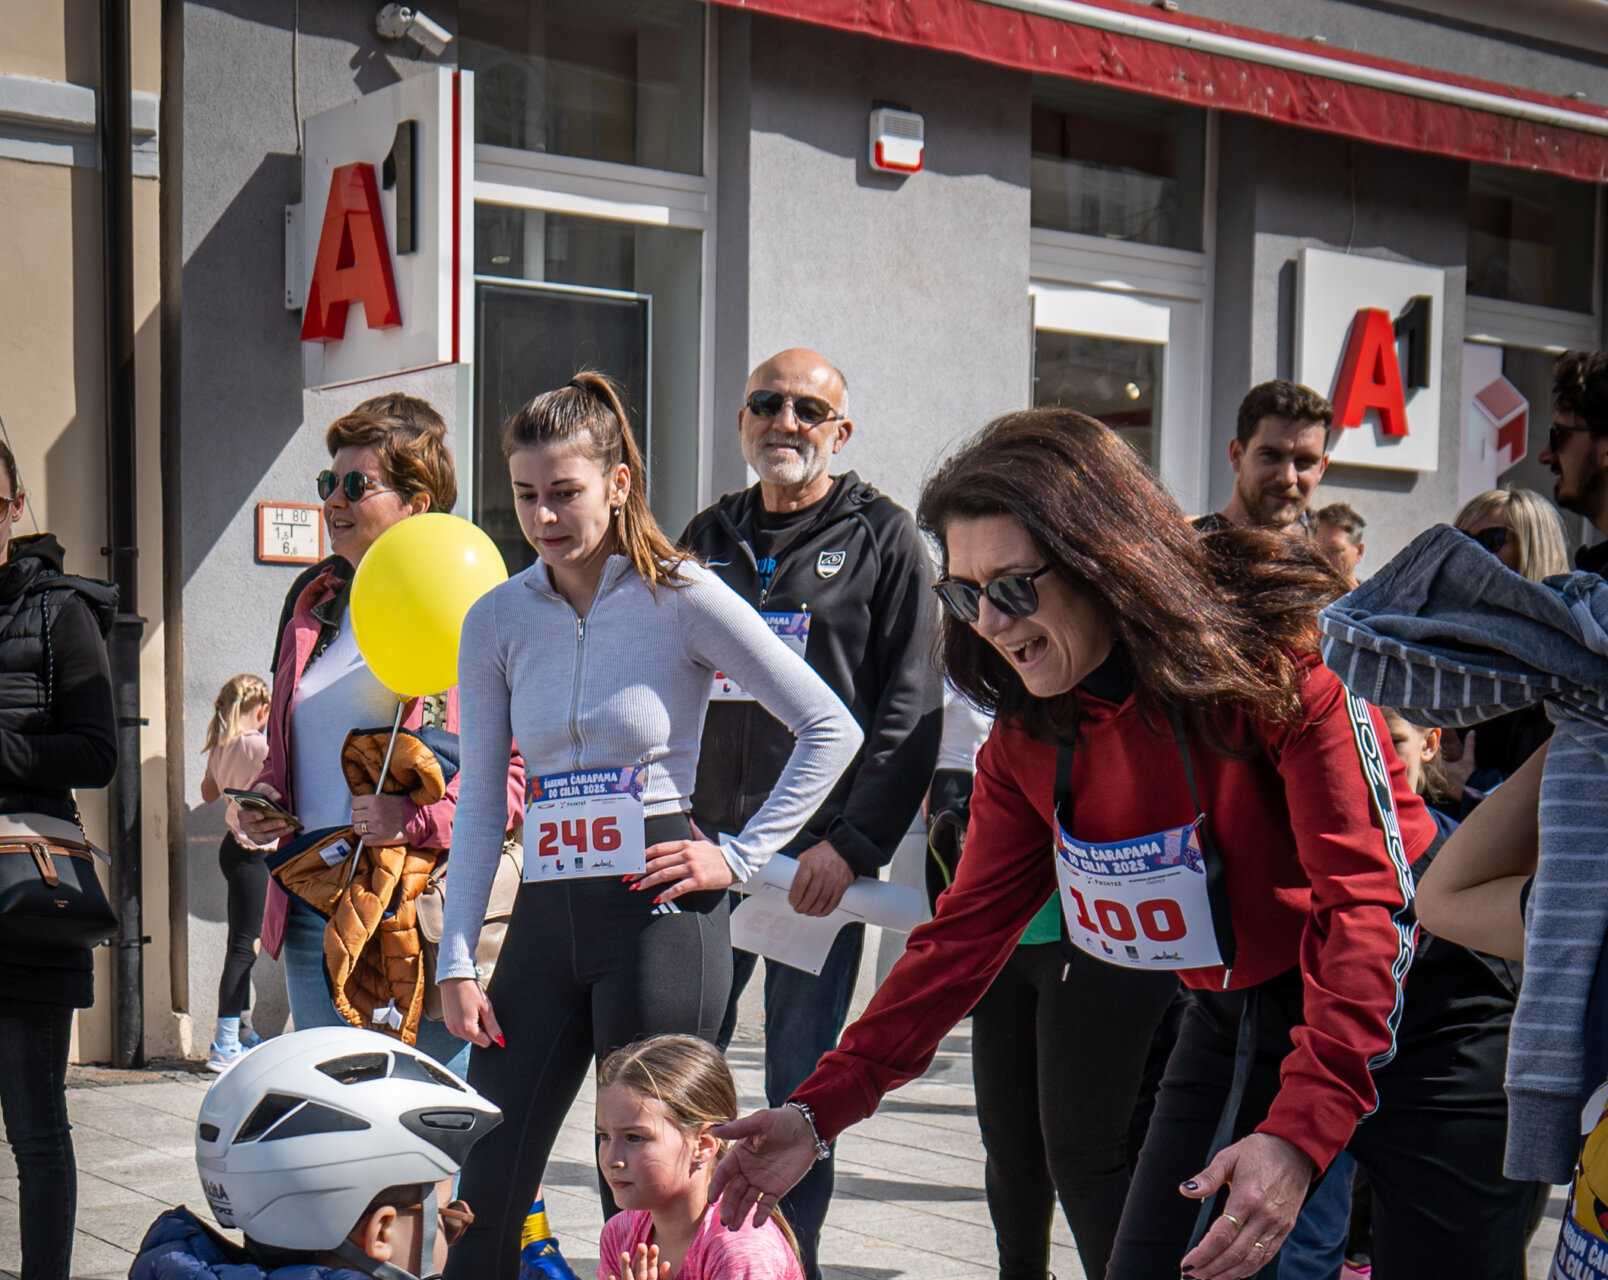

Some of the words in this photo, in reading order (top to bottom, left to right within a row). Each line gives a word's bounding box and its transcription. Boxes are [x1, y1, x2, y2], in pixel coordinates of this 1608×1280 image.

[300, 118, 418, 344] A1
[1331, 294, 1432, 437] A1
[275, 507, 284, 521] H
[292, 509, 308, 523] 80
[1351, 695, 1388, 788] ZOE
[548, 788, 558, 799] DO
[559, 786, 581, 798] CILJA
[582, 783, 608, 795] 2025.
[570, 771, 618, 786] ČARAPAMA
[539, 816, 622, 857] 246
[1090, 841, 1162, 861] ČARAPAMA
[1080, 858, 1110, 874] CILJA
[1112, 859, 1150, 874] 2025.
[1069, 885, 1187, 942] 100
